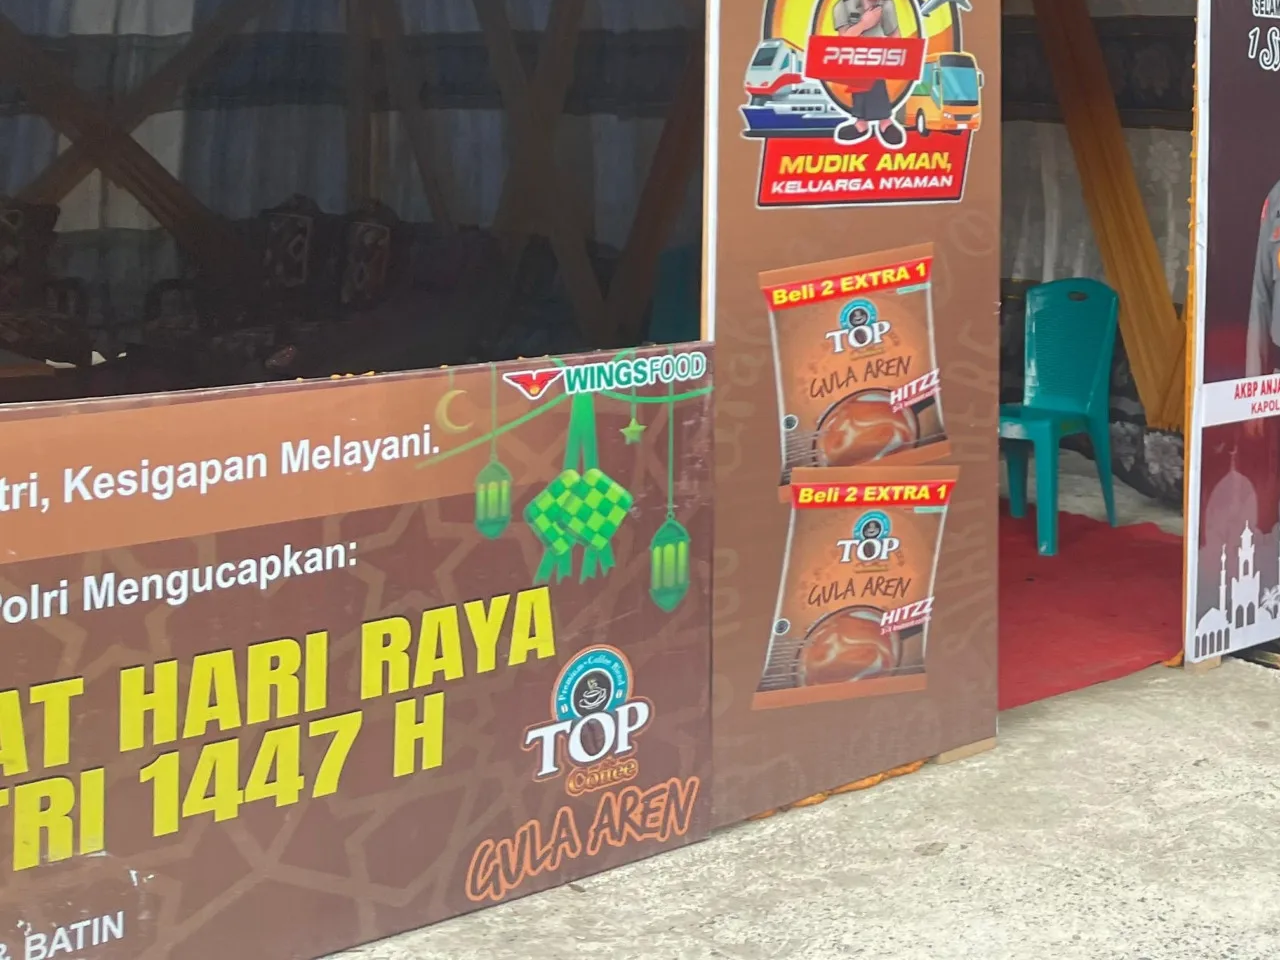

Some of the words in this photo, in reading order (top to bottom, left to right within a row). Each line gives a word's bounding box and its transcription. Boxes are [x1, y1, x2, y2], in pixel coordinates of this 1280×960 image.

[822, 46, 908, 67] PRESISI
[1249, 27, 1260, 58] 1
[779, 154, 869, 175] MUDIK
[875, 151, 952, 173] AMAN,
[771, 178, 874, 195] KELUARGA
[879, 175, 953, 190] NYAMAN
[772, 284, 815, 305] Beli
[821, 280, 834, 296] 2
[840, 266, 910, 293] EXTRA
[916, 263, 926, 277] 1
[824, 321, 891, 353] TOP
[564, 353, 705, 393] WINGSFOOD
[809, 367, 858, 398] GULA
[863, 355, 912, 382] AREN
[889, 368, 940, 406] HITZZ
[1234, 381, 1259, 400] AKBP
[64, 451, 267, 503] Kesigapan
[281, 425, 439, 474] Melayani.
[798, 487, 839, 503] Beli
[844, 487, 857, 502] 2
[863, 485, 930, 501] EXTRA
[937, 485, 947, 499] 1
[836, 537, 899, 563] TOP
[0, 580, 68, 624] olri
[83, 540, 358, 611] Mengucapkan:
[808, 578, 856, 607] GULA
[861, 576, 911, 598] AREN
[880, 596, 935, 626] HITZZ
[119, 631, 327, 753] HARI
[360, 586, 556, 701] RAYA
[525, 701, 649, 777] TOP
[139, 711, 362, 837] 1447
[393, 691, 444, 777] H
[468, 809, 580, 902] GULA
[587, 777, 698, 855] AREN
[25, 911, 124, 960] BATIN
